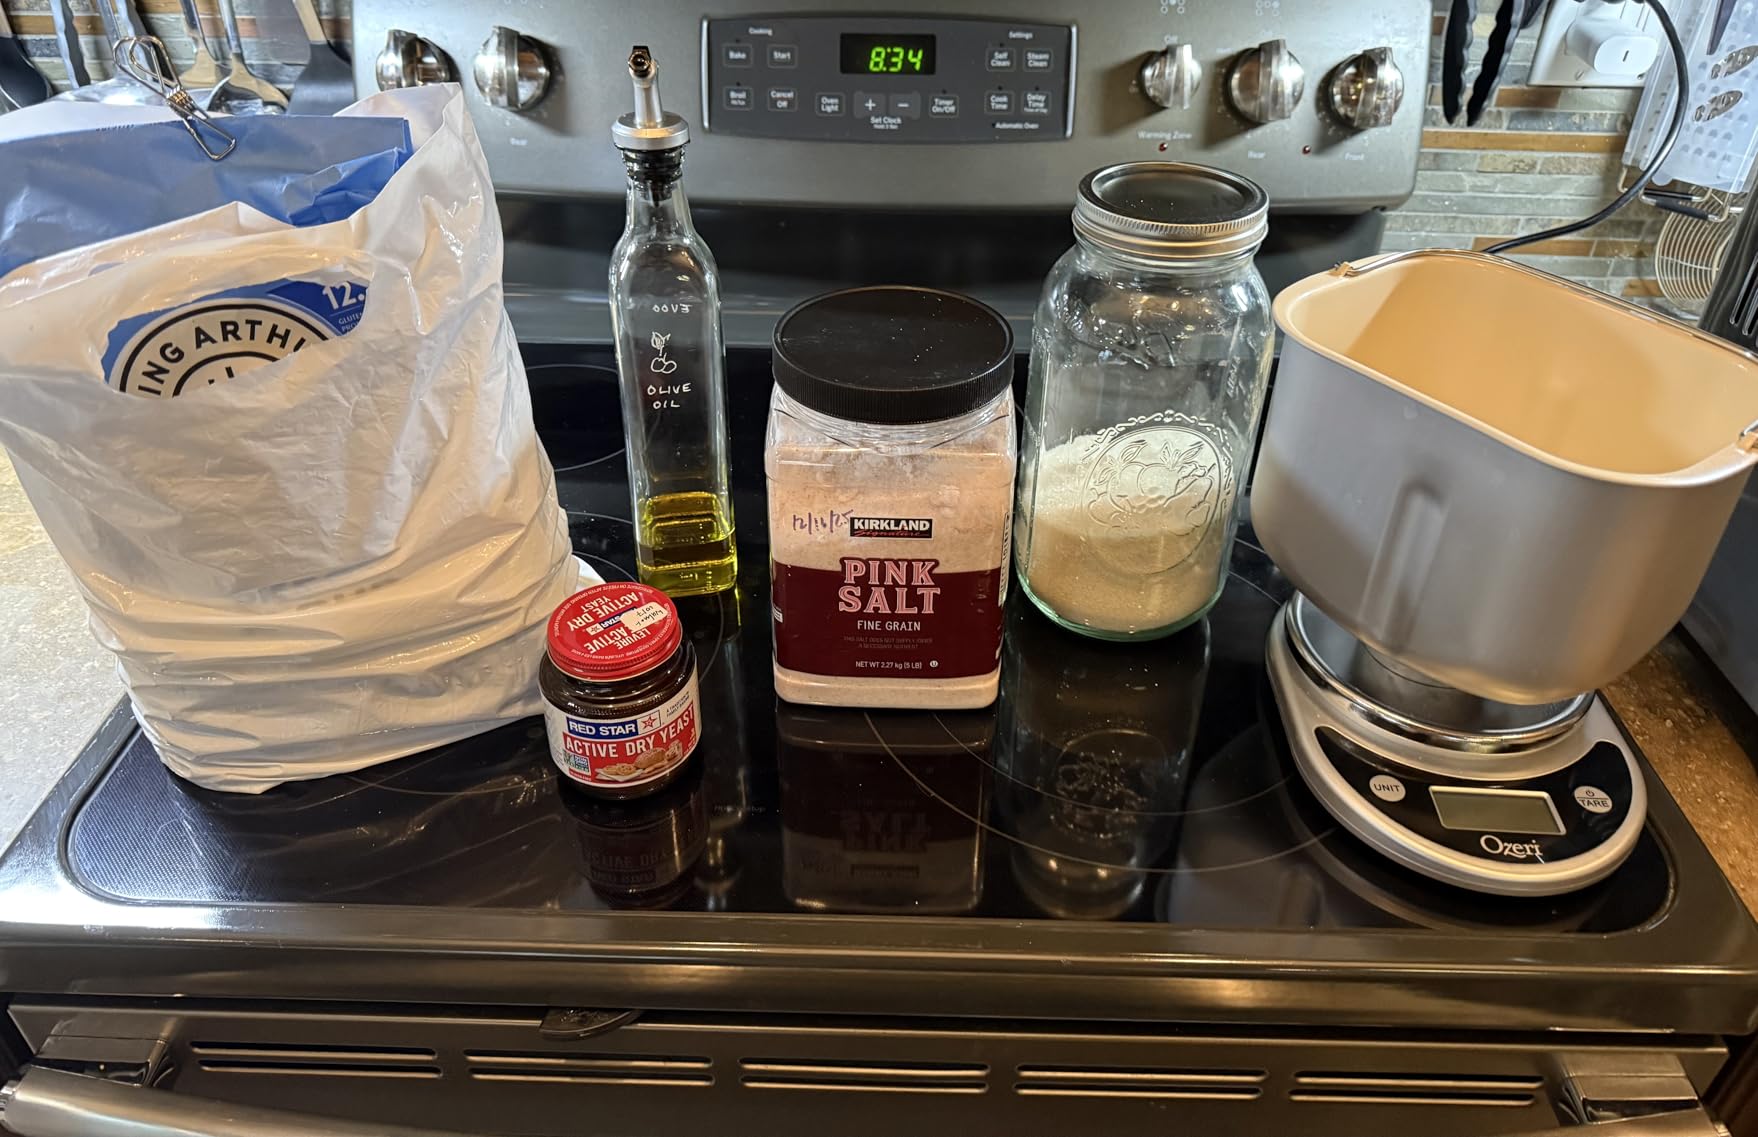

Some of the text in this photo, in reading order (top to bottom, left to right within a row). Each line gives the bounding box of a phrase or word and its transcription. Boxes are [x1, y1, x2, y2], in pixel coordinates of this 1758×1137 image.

[729, 51, 747, 59] Bake
[773, 51, 791, 60] Start
[869, 46, 923, 72] 8:34
[994, 51, 1008, 60] Self
[1026, 52, 1050, 60] Steam
[729, 91, 746, 99] Broil
[770, 90, 794, 98] Cancel
[990, 95, 1008, 103] Cook
[1026, 93, 1046, 102] Delay
[776, 100, 788, 108] Off
[821, 104, 839, 113] Light
[932, 105, 956, 113] On/Off
[991, 102, 1008, 110] Time
[870, 116, 902, 124] Set Clock
[1137, 130, 1171, 140] Warming
[322, 281, 365, 310] 12.
[338, 312, 362, 325] GLUTE
[138, 342, 185, 396] ING
[647, 382, 691, 396] OLIVE
[653, 400, 680, 410] OIL
[853, 518, 930, 531] KIRKLAND
[854, 529, 931, 538] Signature
[843, 559, 936, 586] PINK
[581, 595, 611, 612] YEAST
[592, 591, 639, 618] ACTIVE
[838, 586, 941, 614] SALT
[567, 613, 594, 631] DRY
[601, 615, 621, 627] STAR
[857, 620, 921, 631] FINE GRAIN
[583, 627, 628, 653] ACTIVE
[614, 628, 651, 650] LEVURE
[894, 662, 903, 670] kg
[911, 662, 922, 670] LB)
[566, 737, 619, 758] ACTIVE
[625, 737, 655, 756] DRY
[659, 703, 694, 744] YEAST
[569, 720, 636, 736] RED STAR
[1373, 783, 1401, 793] UNIT
[1579, 798, 1608, 808] TARE
[1480, 834, 1543, 858] Ozeri
